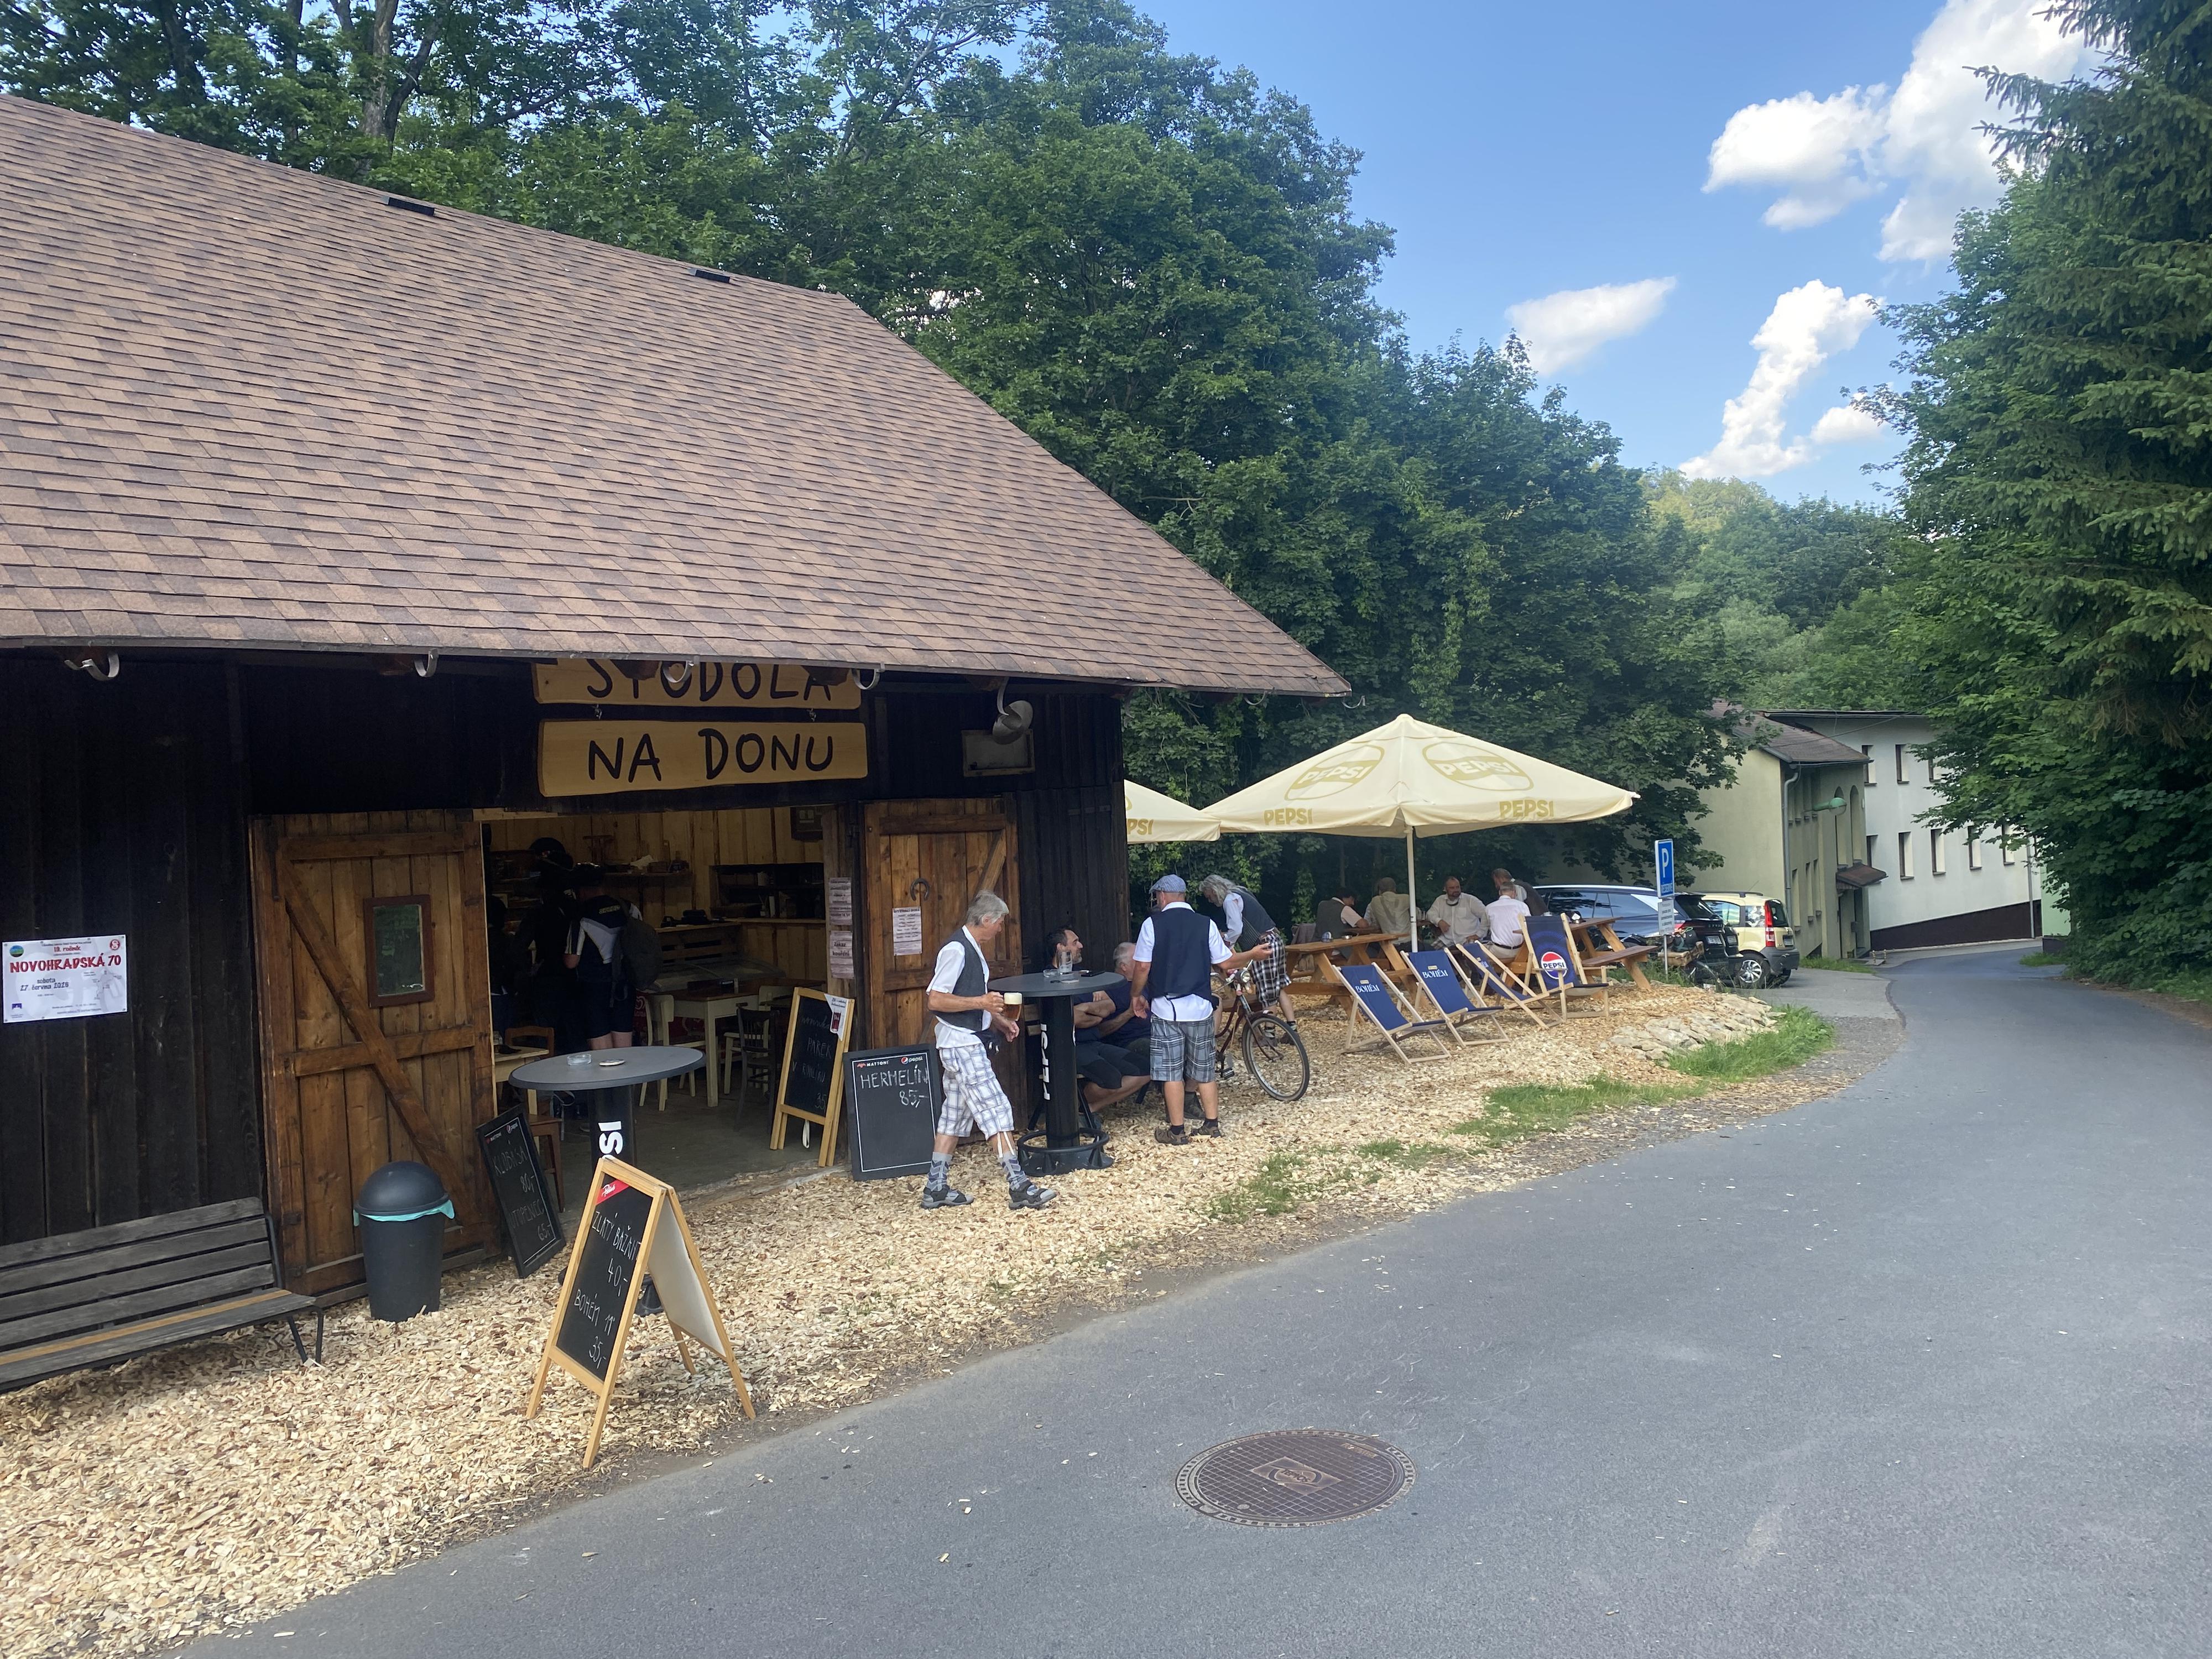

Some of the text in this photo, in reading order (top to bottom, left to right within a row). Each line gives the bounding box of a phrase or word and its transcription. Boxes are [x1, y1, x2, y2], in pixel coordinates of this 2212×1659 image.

[588, 728, 833, 783] NA DONU
[1297, 765, 1373, 784] PEPSI
[1433, 760, 1520, 775] PEPSI
[1264, 807, 1314, 826] PEPSI
[1499, 799, 1554, 818] PEPSI
[1661, 848, 1669, 878] P
[10, 953, 105, 973] NOVOHRADSKÁ
[1422, 969, 1449, 978] BOHÉM
[1355, 983, 1380, 993] BOHÉM
[860, 1064, 928, 1089] HERMELÍN
[598, 1120, 623, 1159] SI
[592, 1211, 618, 1241] ZLATÝ
